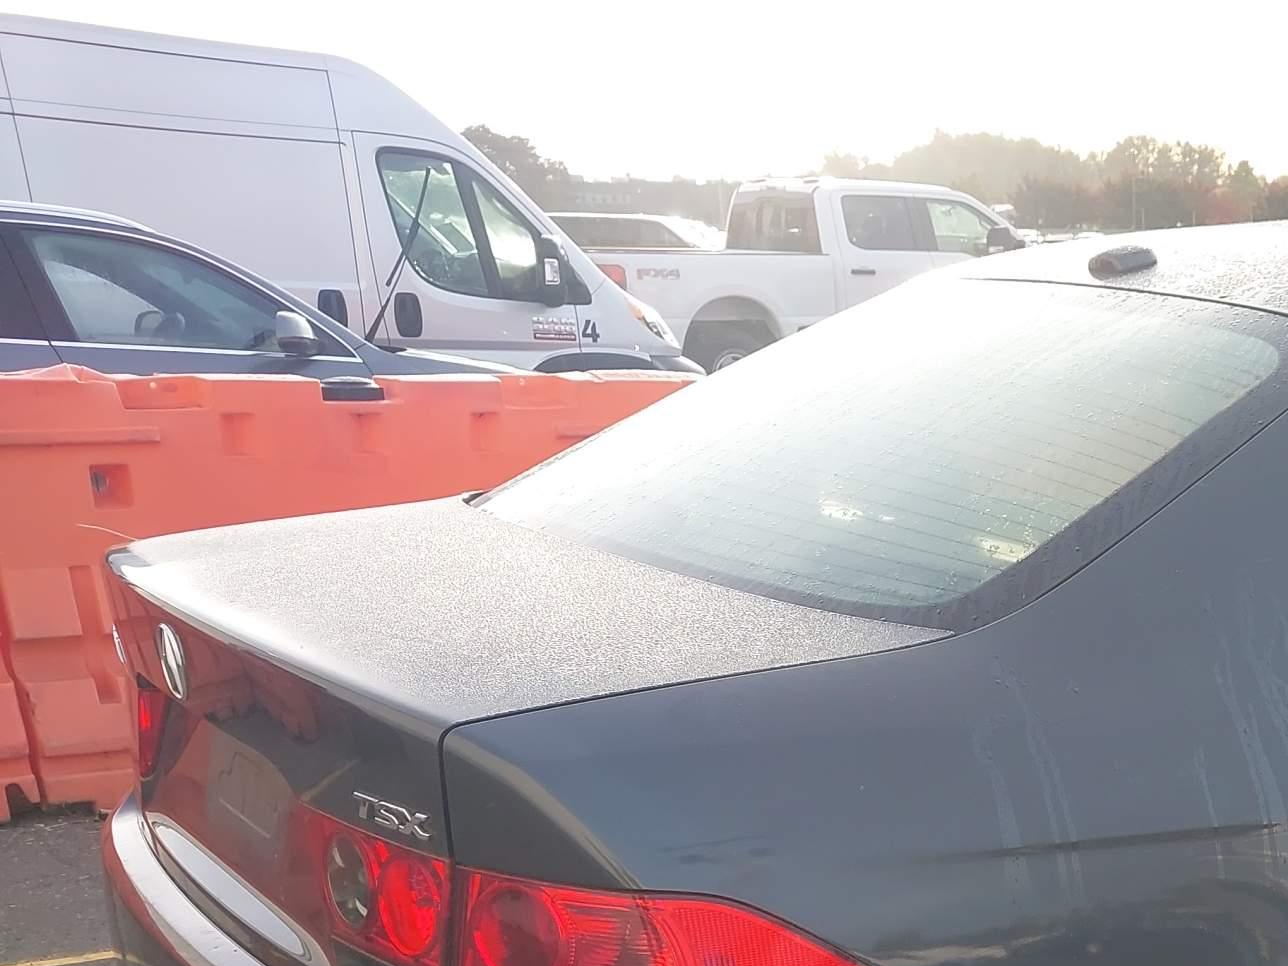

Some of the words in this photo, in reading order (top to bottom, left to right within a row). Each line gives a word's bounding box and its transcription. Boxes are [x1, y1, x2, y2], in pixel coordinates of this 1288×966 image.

[636, 268, 681, 281] FX4
[581, 319, 601, 343] 4
[352, 791, 431, 840] TSX
